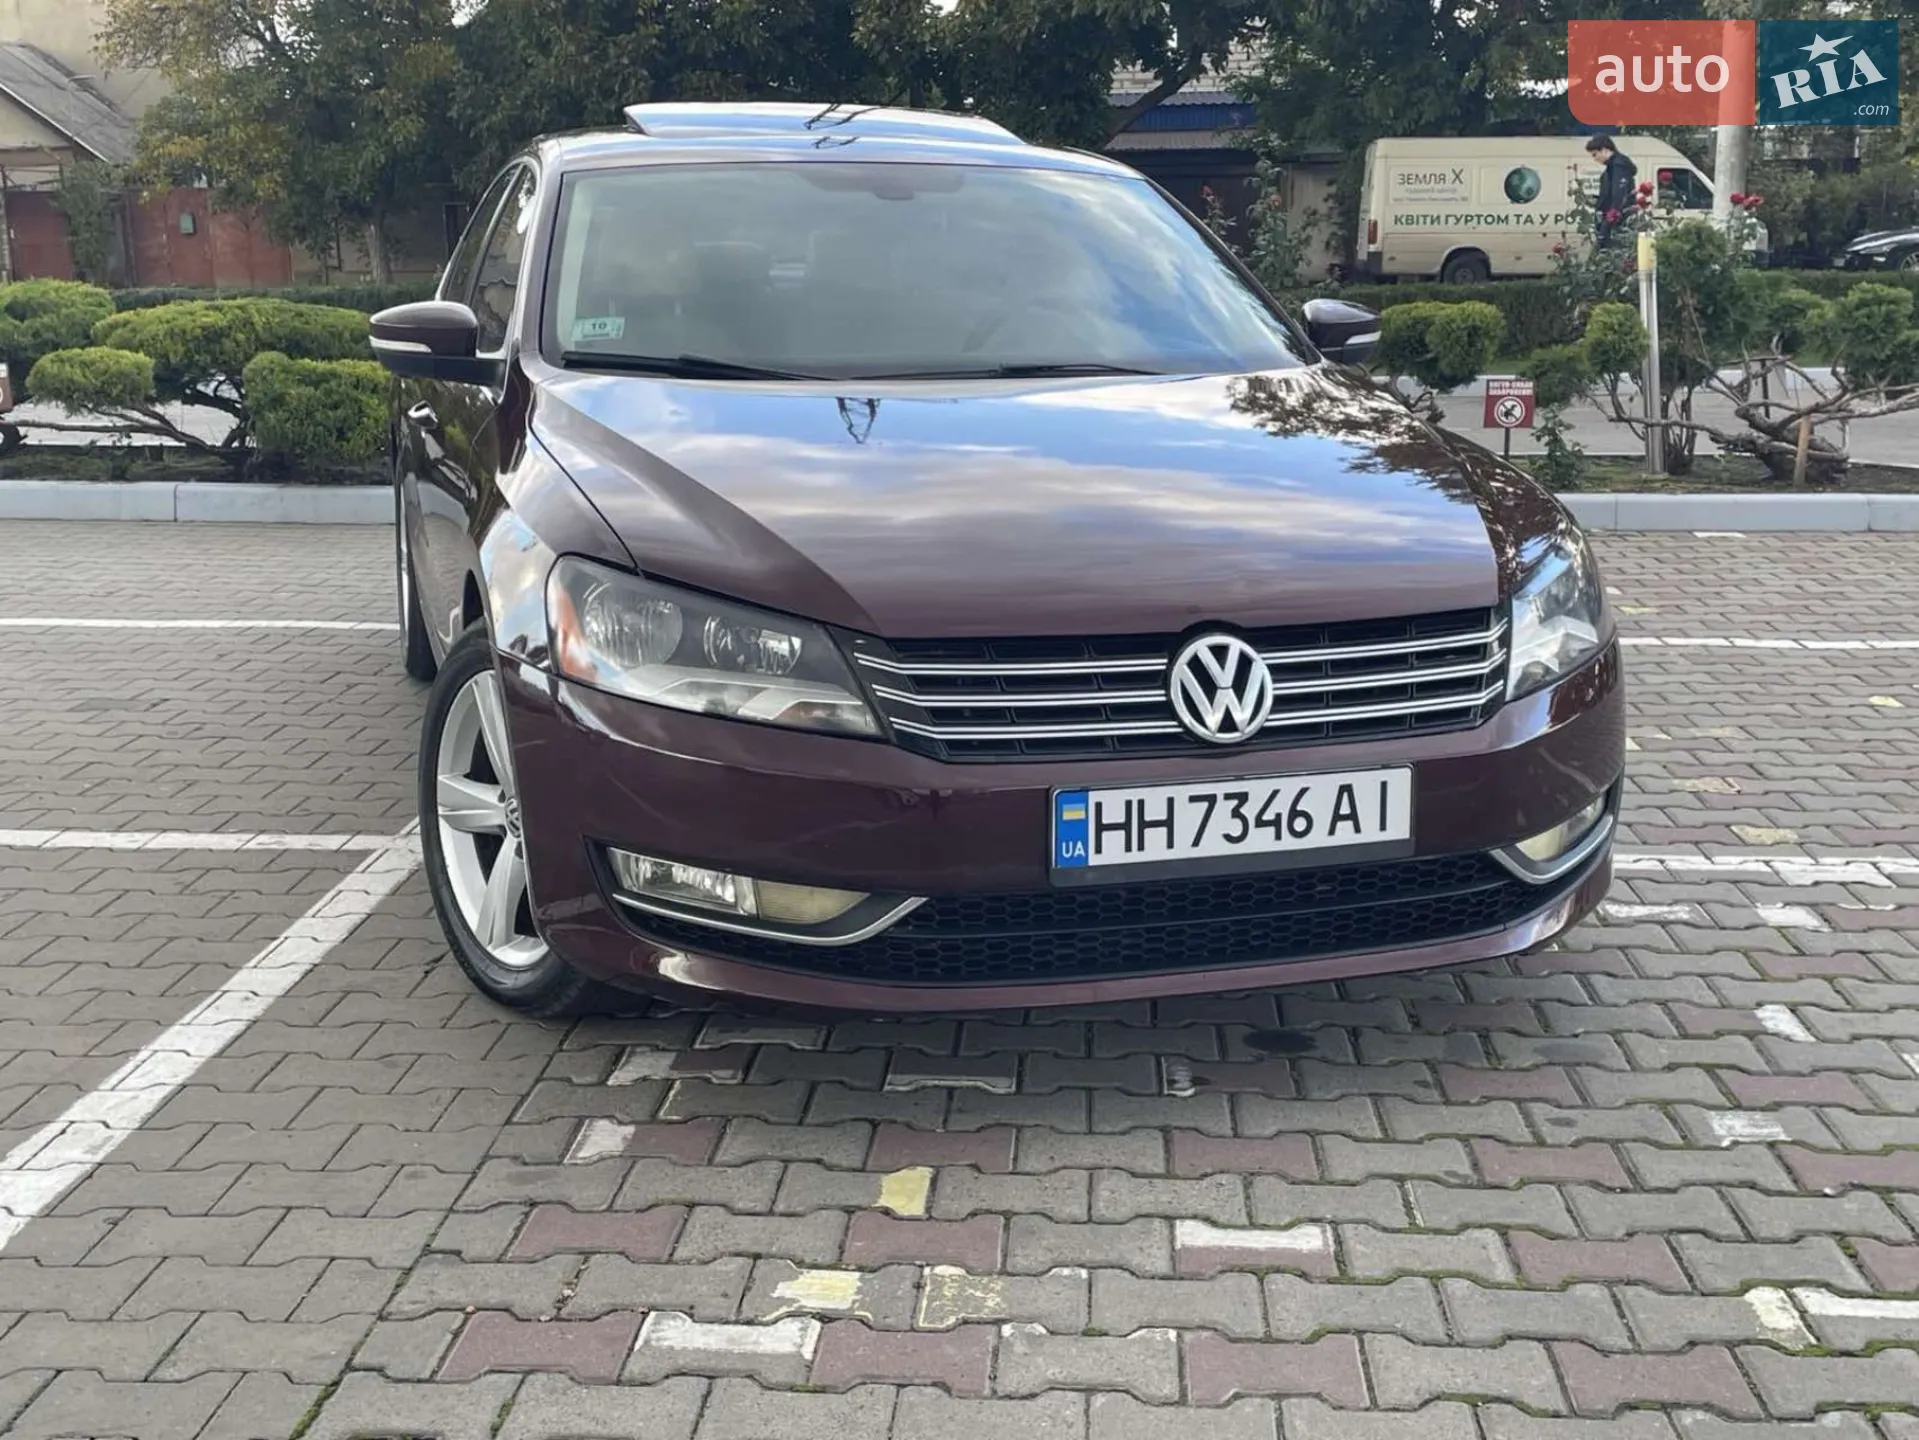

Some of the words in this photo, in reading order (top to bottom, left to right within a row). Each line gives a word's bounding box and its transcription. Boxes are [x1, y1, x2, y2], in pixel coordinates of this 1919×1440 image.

[1397, 173, 1447, 185] ЗЕМЛЯ
[1394, 214, 1441, 225] КВІТИ
[1445, 213, 1509, 225] ГУРТОМ
[1513, 213, 1534, 225] ТА
[1539, 213, 1550, 225] У
[1061, 840, 1086, 860] UA
